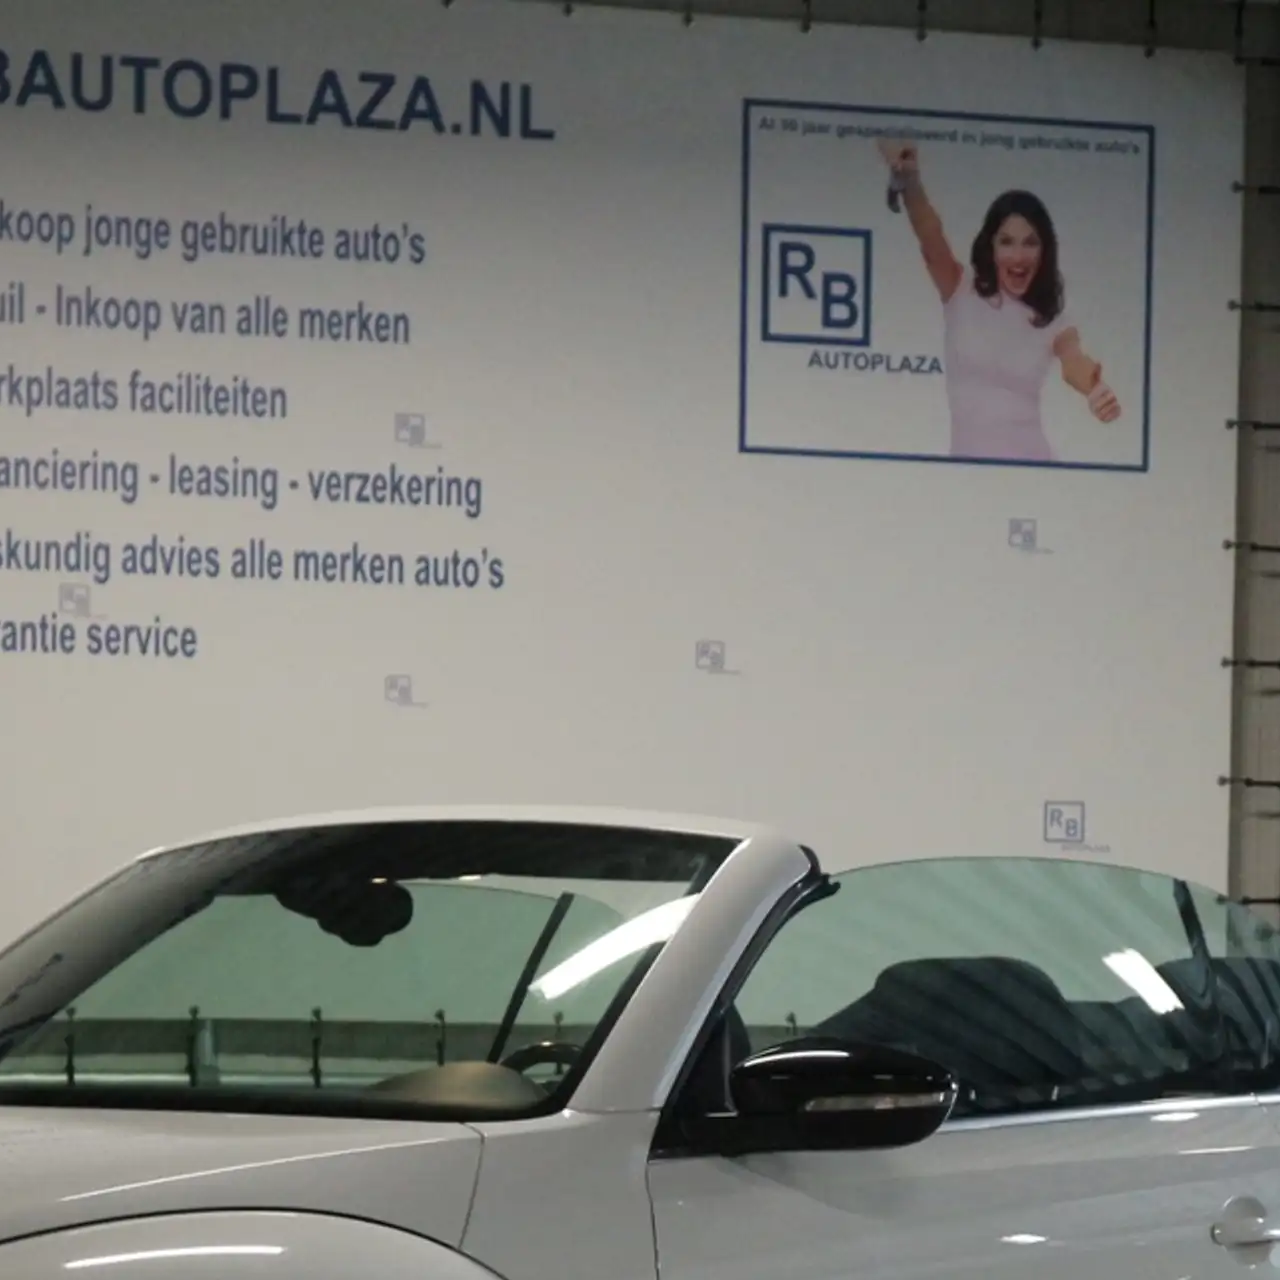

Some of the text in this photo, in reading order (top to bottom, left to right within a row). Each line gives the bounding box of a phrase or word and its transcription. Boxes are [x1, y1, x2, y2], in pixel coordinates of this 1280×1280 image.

[83, 204, 171, 260] jonge
[181, 212, 324, 262] gebruikte
[335, 223, 425, 264] auto's
[56, 284, 161, 340] Inkoop
[172, 302, 225, 333] van
[236, 295, 288, 338] alle
[299, 301, 409, 343] merken
[808, 349, 943, 374] AUTOPLAZA
[129, 369, 286, 418] faciliteiten
[170, 454, 278, 510] leasing
[308, 464, 481, 519] verzekering
[122, 534, 220, 578] advies
[231, 539, 283, 580] alle
[294, 542, 404, 584] merken
[415, 548, 504, 589] auto's
[87, 616, 197, 657] service
